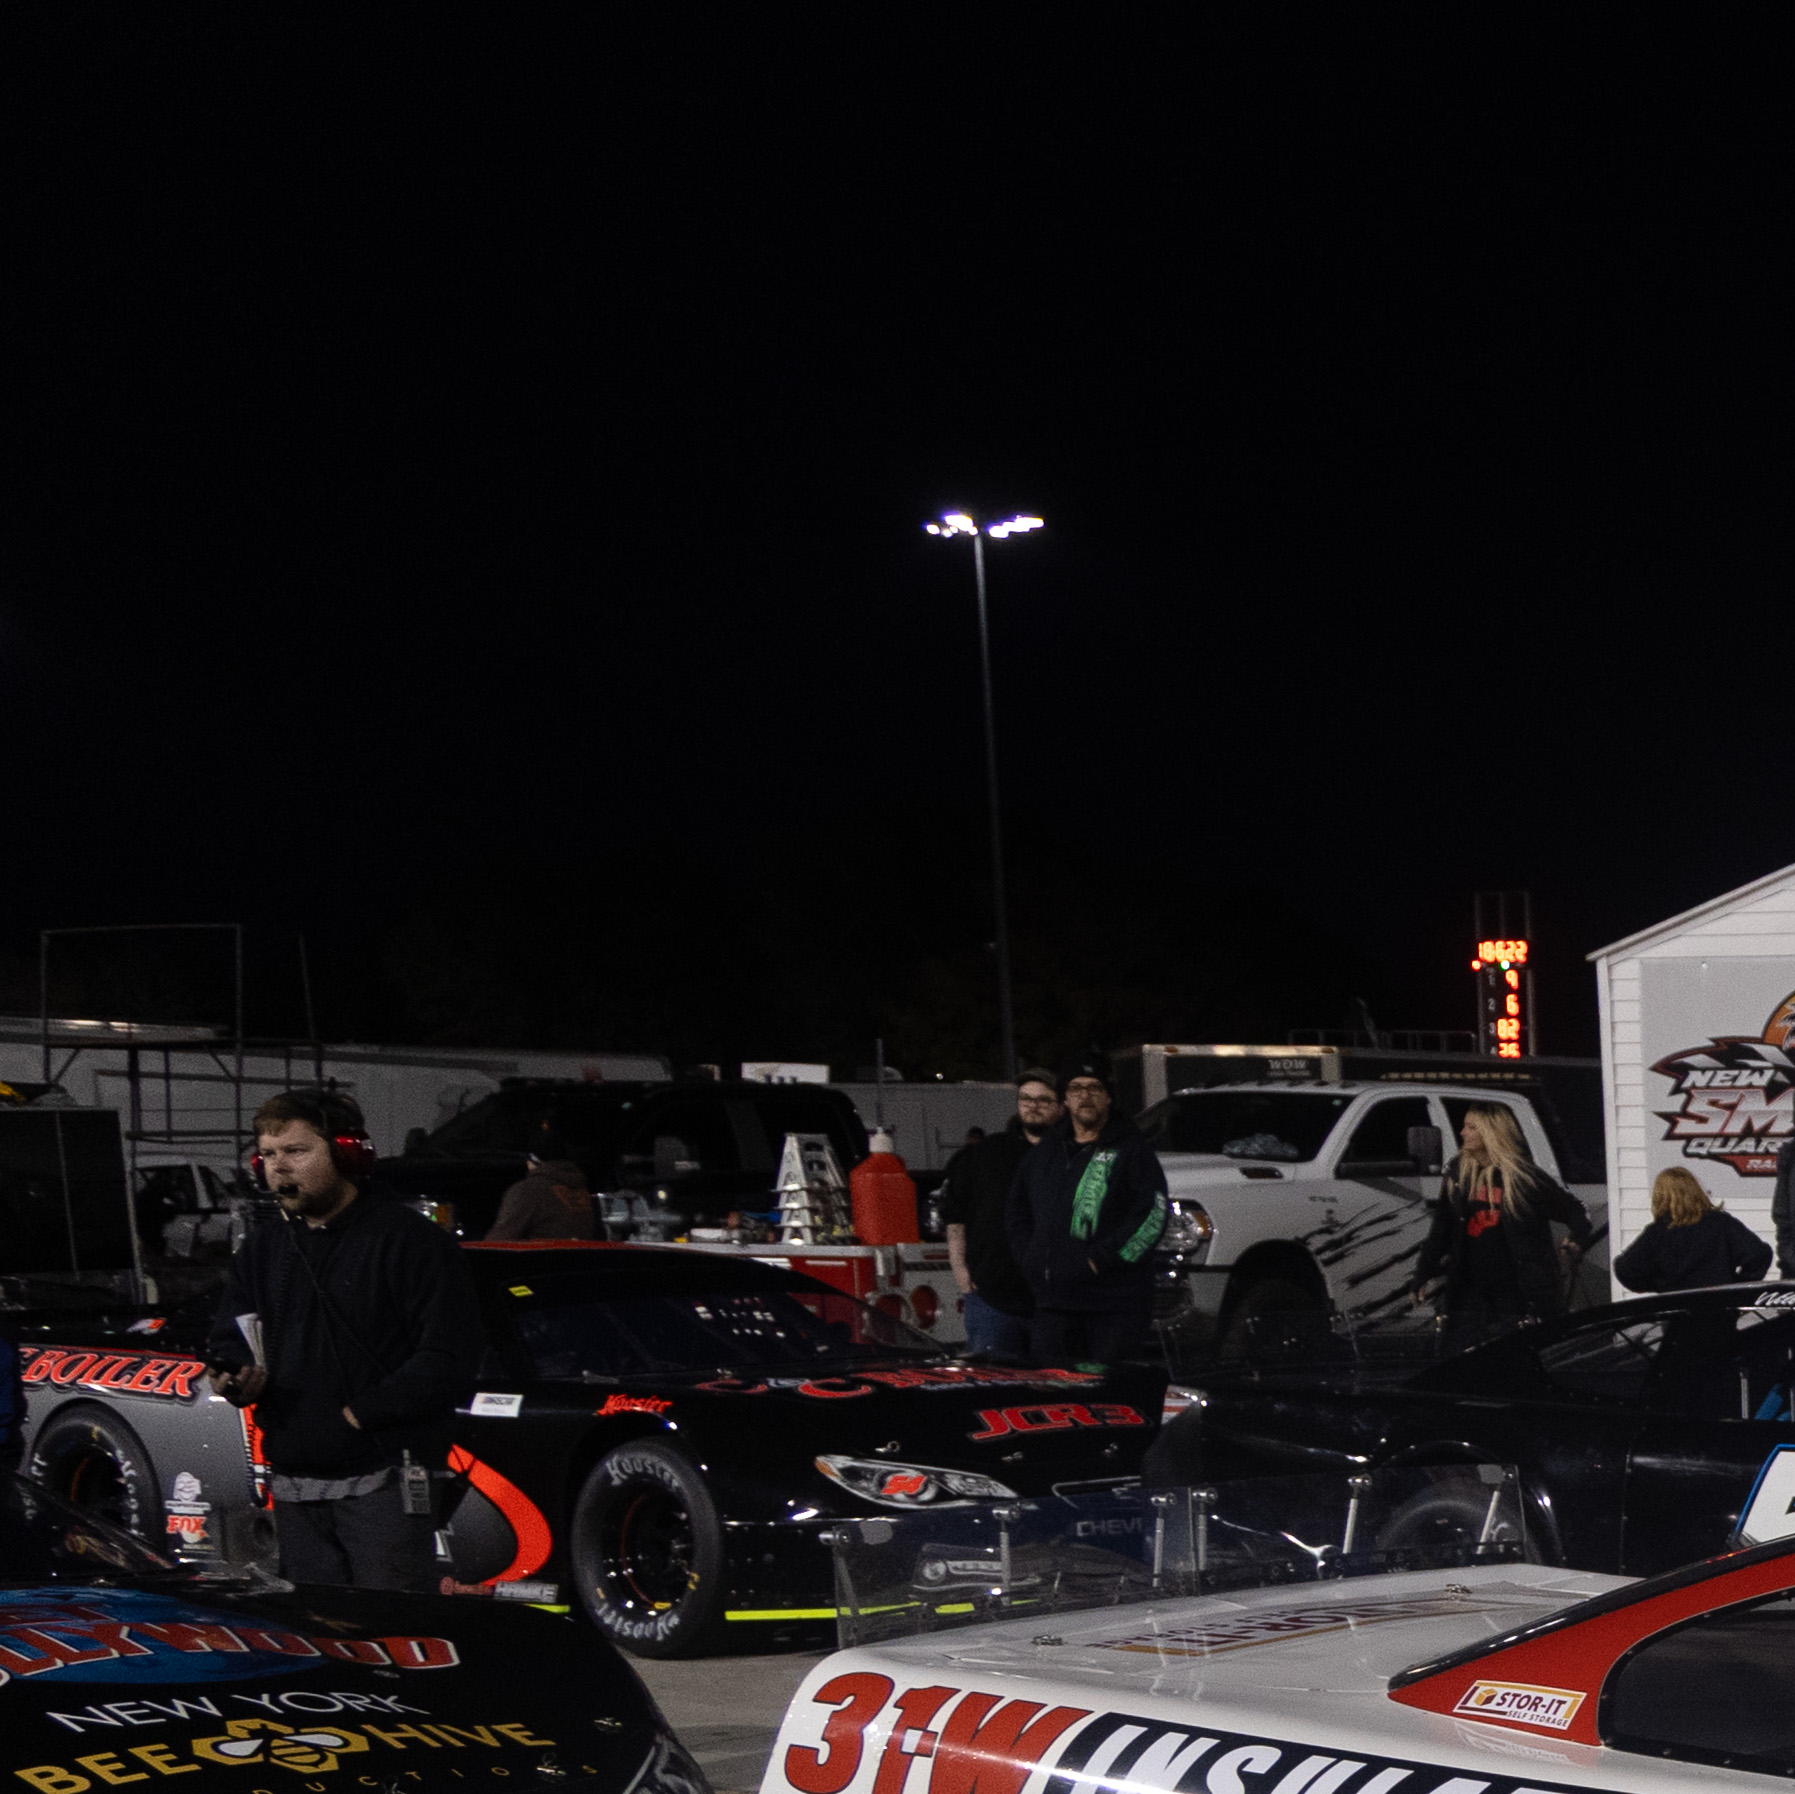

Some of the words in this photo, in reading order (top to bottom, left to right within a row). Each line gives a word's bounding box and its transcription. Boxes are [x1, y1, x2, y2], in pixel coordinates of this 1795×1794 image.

[1683, 1069, 1770, 1087] NEW
[966, 1402, 1152, 1444] JCR3
[45, 1697, 224, 1734] NEW
[231, 1691, 432, 1716] YORK
[1496, 1692, 1568, 1716] STOR-IT
[361, 1722, 558, 1750] HIVE
